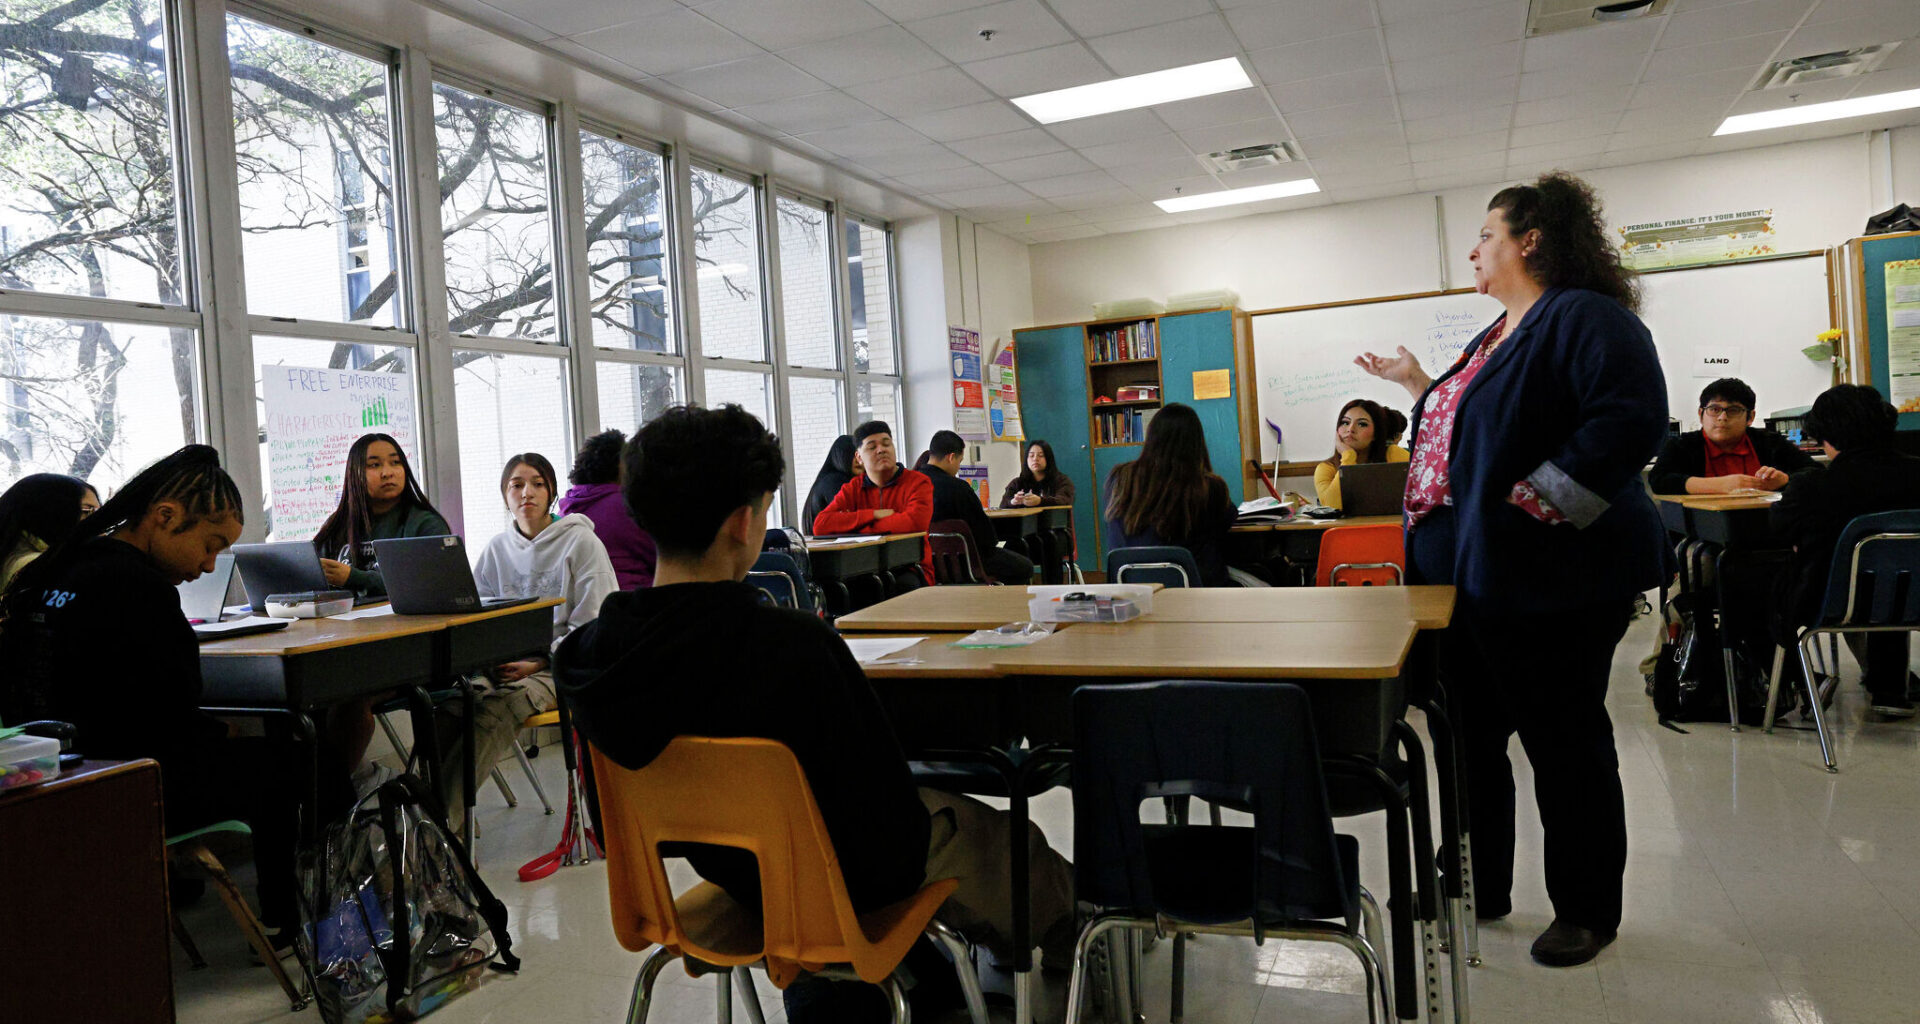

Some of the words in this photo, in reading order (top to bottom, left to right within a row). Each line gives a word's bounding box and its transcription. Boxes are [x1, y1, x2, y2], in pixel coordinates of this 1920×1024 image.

[1627, 223, 1663, 231] PERSONAL
[1665, 218, 1696, 226] FINANCE:
[1713, 213, 1734, 221] YOUR
[288, 369, 330, 391] FREE
[340, 374, 400, 391] ENTERPRISE
